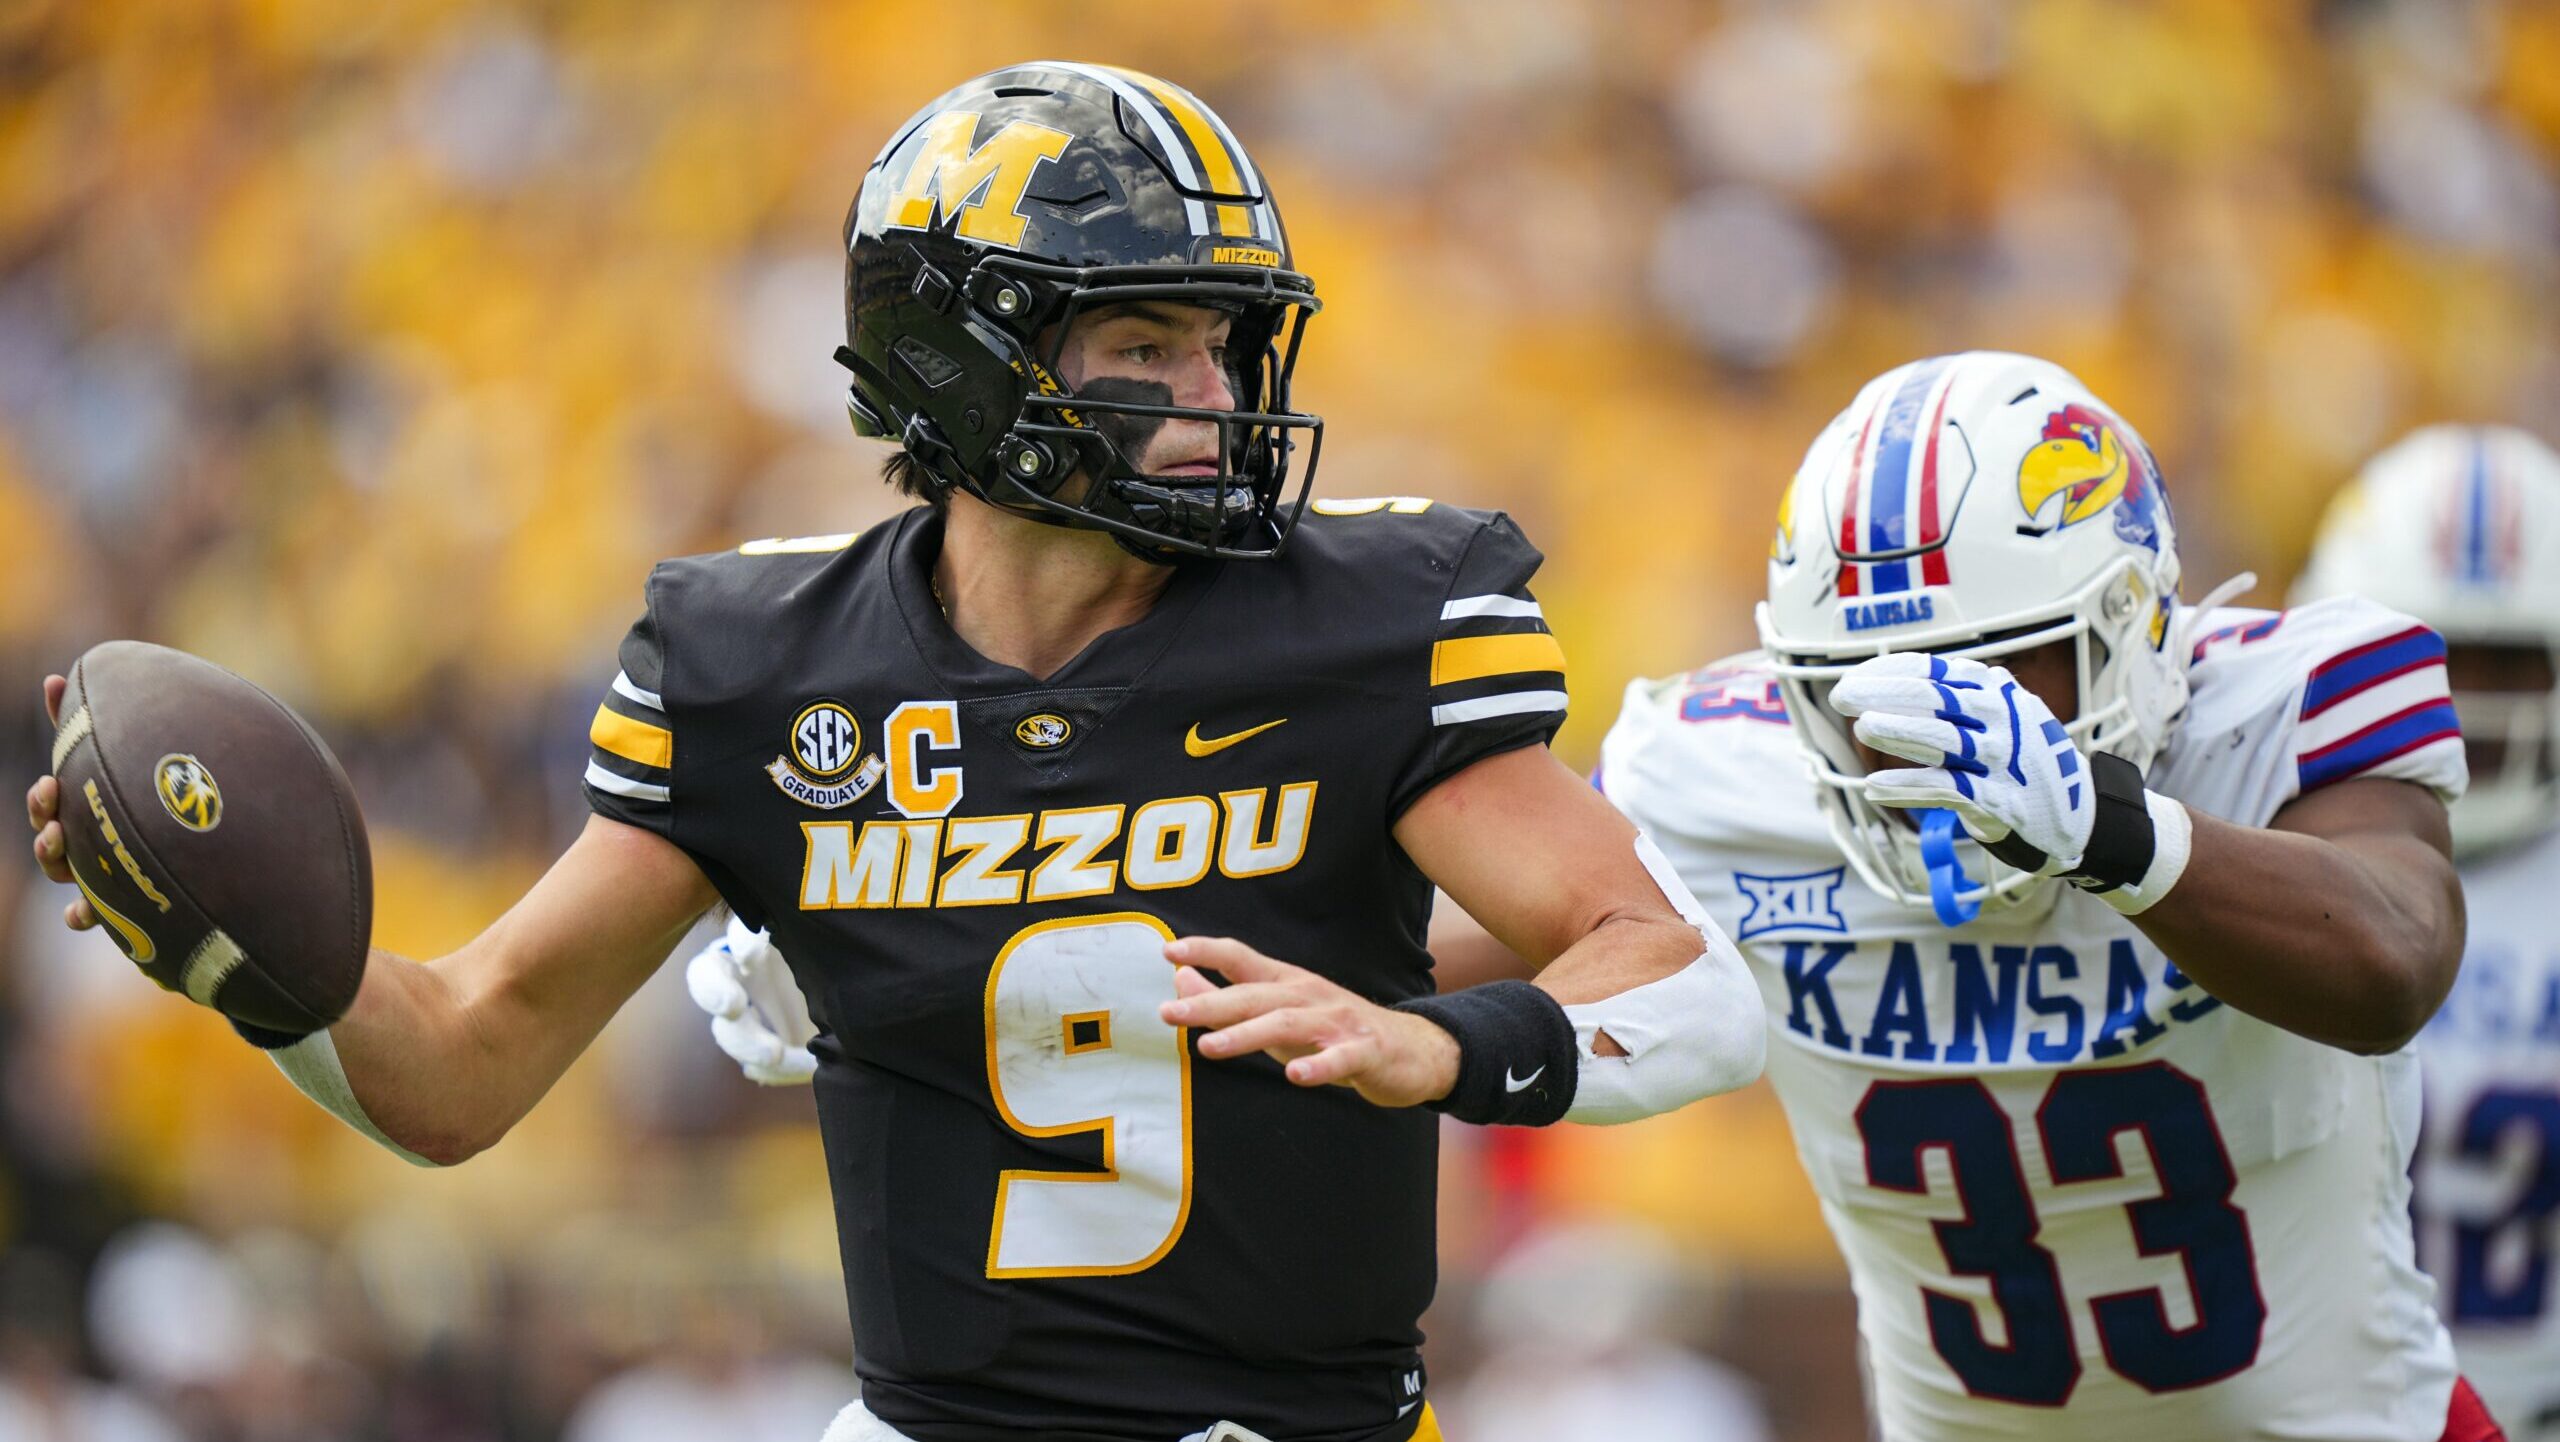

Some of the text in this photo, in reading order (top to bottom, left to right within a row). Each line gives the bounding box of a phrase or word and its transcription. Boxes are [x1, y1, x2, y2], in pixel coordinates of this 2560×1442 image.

[883, 111, 1074, 251] M
[1213, 247, 1279, 268] MIZZOU
[1844, 595, 1934, 632] KANSAS
[797, 709, 853, 772] SEC
[884, 700, 964, 820] C
[783, 775, 869, 805] GRADUATE
[799, 780, 1319, 911] MIZZOU
[984, 911, 1194, 1279] 9
[1854, 1060, 2269, 1407] 33
[1403, 1370, 1421, 1396] M
